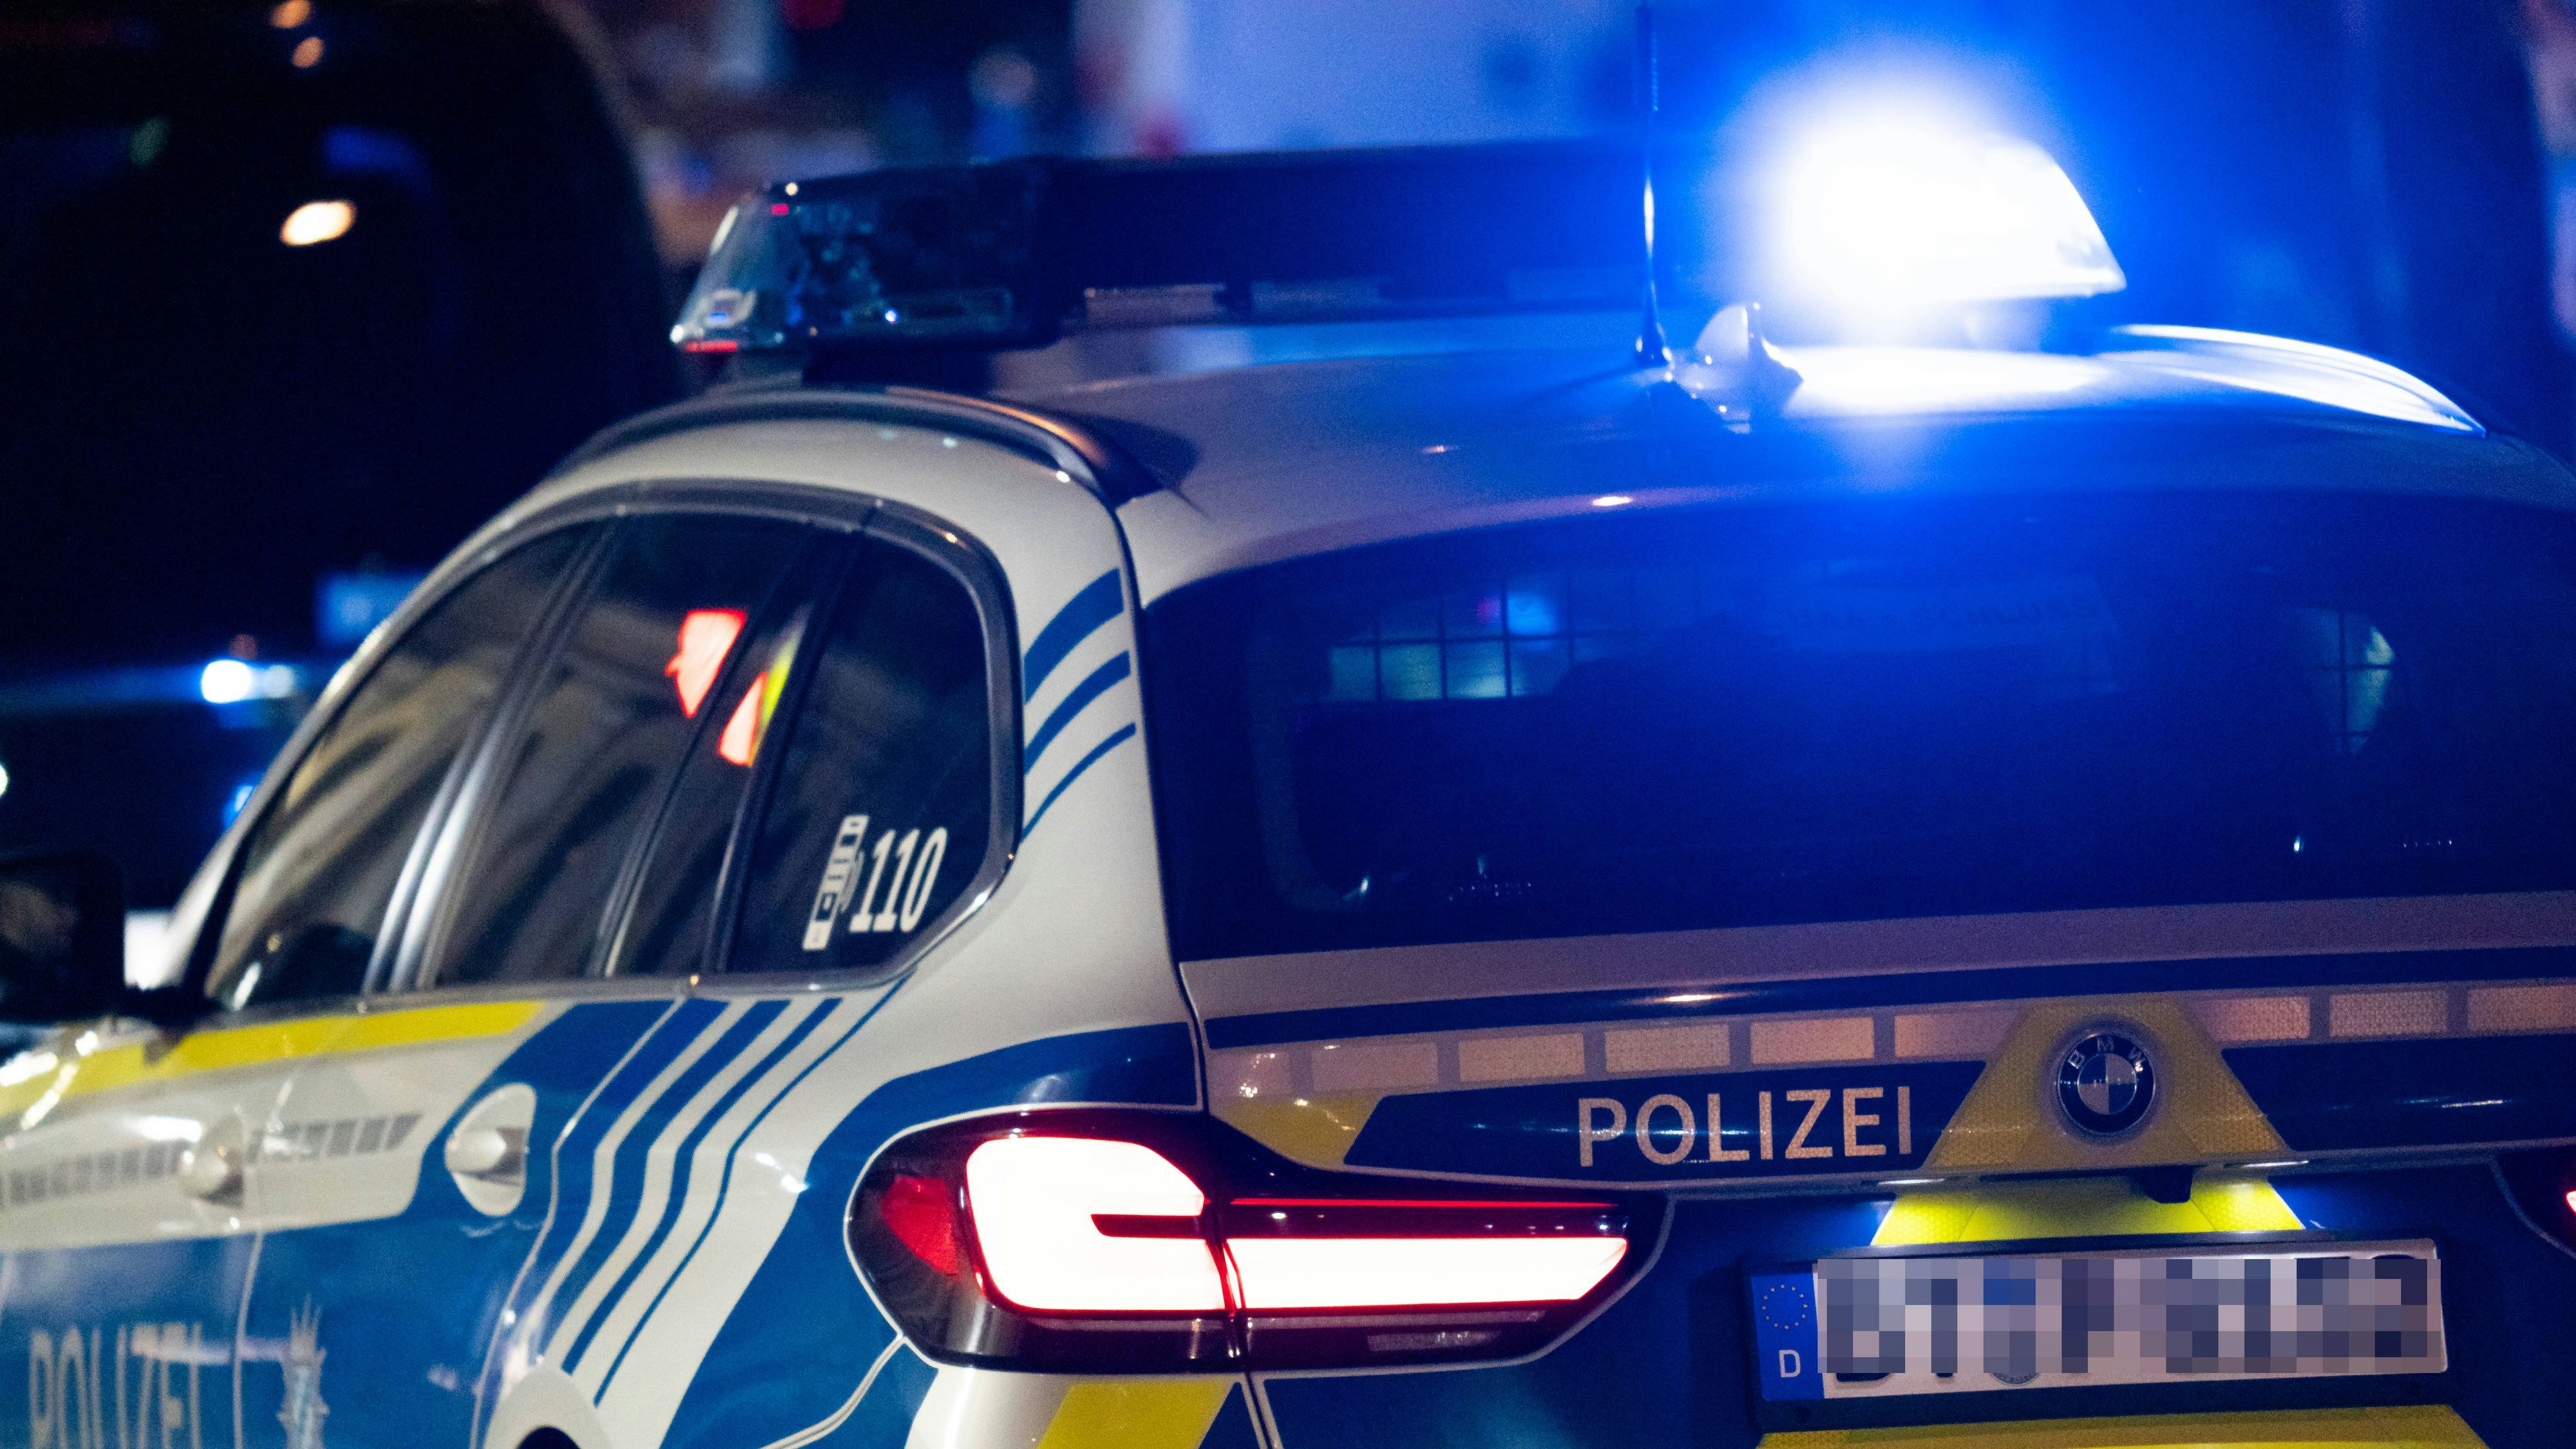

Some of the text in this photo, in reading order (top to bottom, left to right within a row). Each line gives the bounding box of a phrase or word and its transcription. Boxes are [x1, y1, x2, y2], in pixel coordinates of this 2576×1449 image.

[848, 827, 948, 933] 110
[2067, 1036, 2146, 1072] BMW
[1578, 1086, 1912, 1168] POLIZEI
[1779, 1349, 1801, 1378] D
